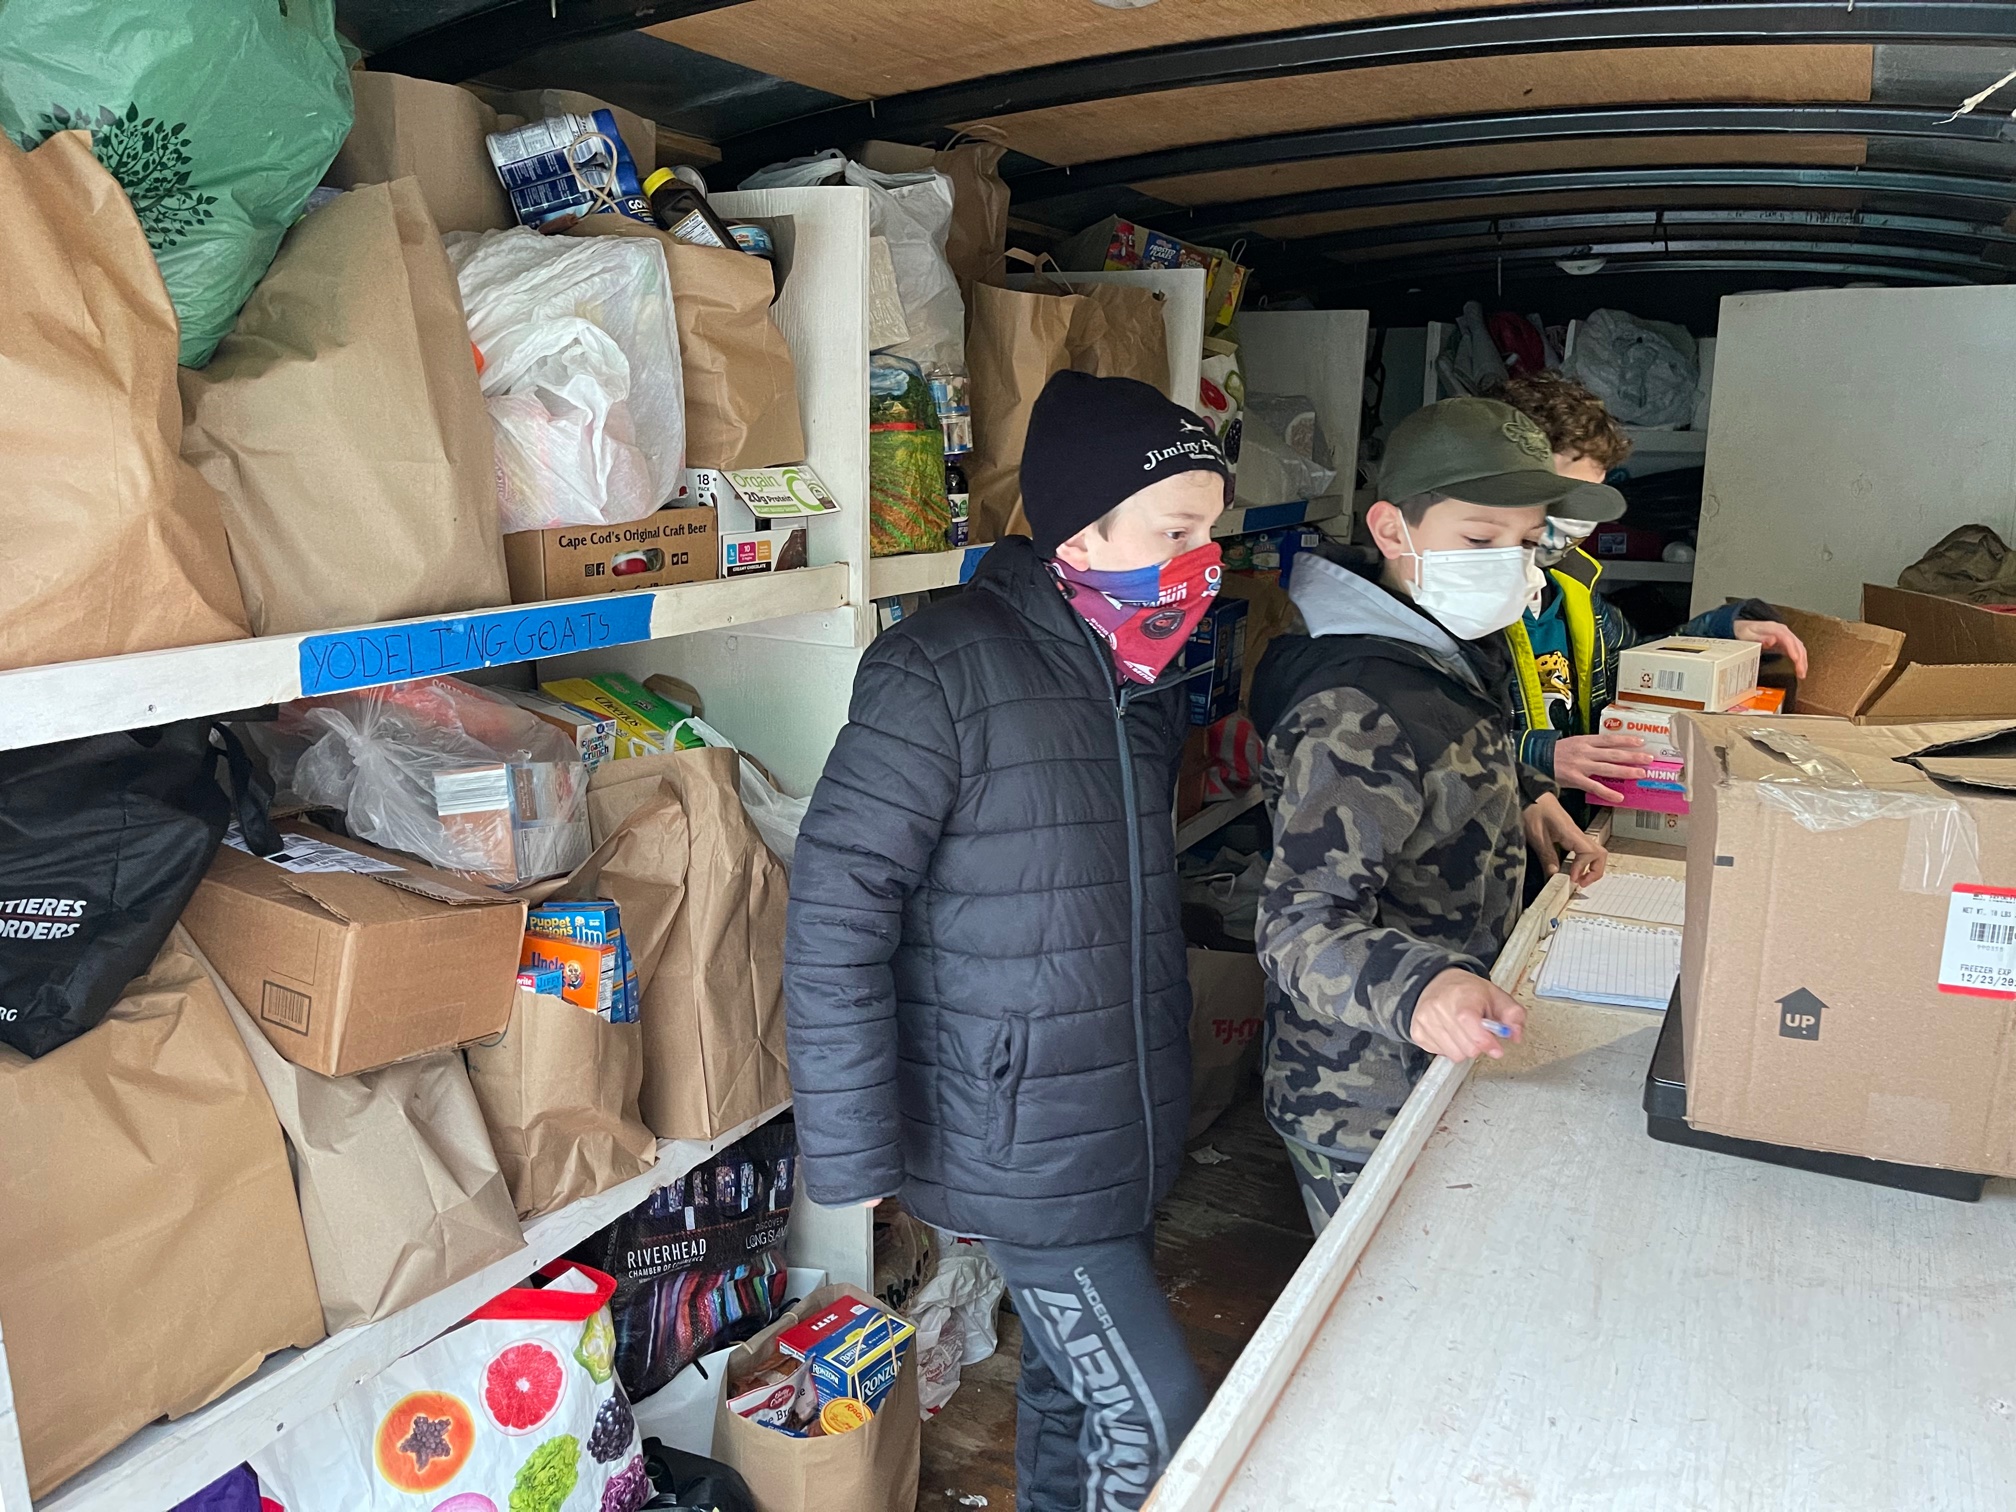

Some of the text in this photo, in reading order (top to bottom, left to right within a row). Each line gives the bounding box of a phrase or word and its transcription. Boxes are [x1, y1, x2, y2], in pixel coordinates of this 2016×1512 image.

[1143, 441, 1201, 471] Jiminy
[696, 474, 710, 486] 18
[731, 472, 781, 493] Orgain
[743, 491, 794, 504] 20g Protein
[558, 523, 708, 549] Cape Cod's Original Craft Beer
[513, 611, 611, 656] GOATS
[582, 745, 609, 761] Crunch
[529, 916, 571, 928] Puppet
[531, 951, 566, 971] Uncle
[1960, 963, 2012, 977] FREEZER EXP
[537, 974, 561, 988] JIFFY
[1785, 1013, 1815, 1028] UP
[755, 1216, 784, 1232] DISCOVER
[745, 1232, 767, 1250] LONG
[627, 1238, 707, 1269] RIVERHEAD
[628, 1263, 662, 1279] CHAMBER
[663, 1264, 671, 1272] OF
[1074, 1267, 1115, 1330] UNDER
[811, 1313, 839, 1331] ZITI
[812, 1363, 839, 1385] RONZONI
